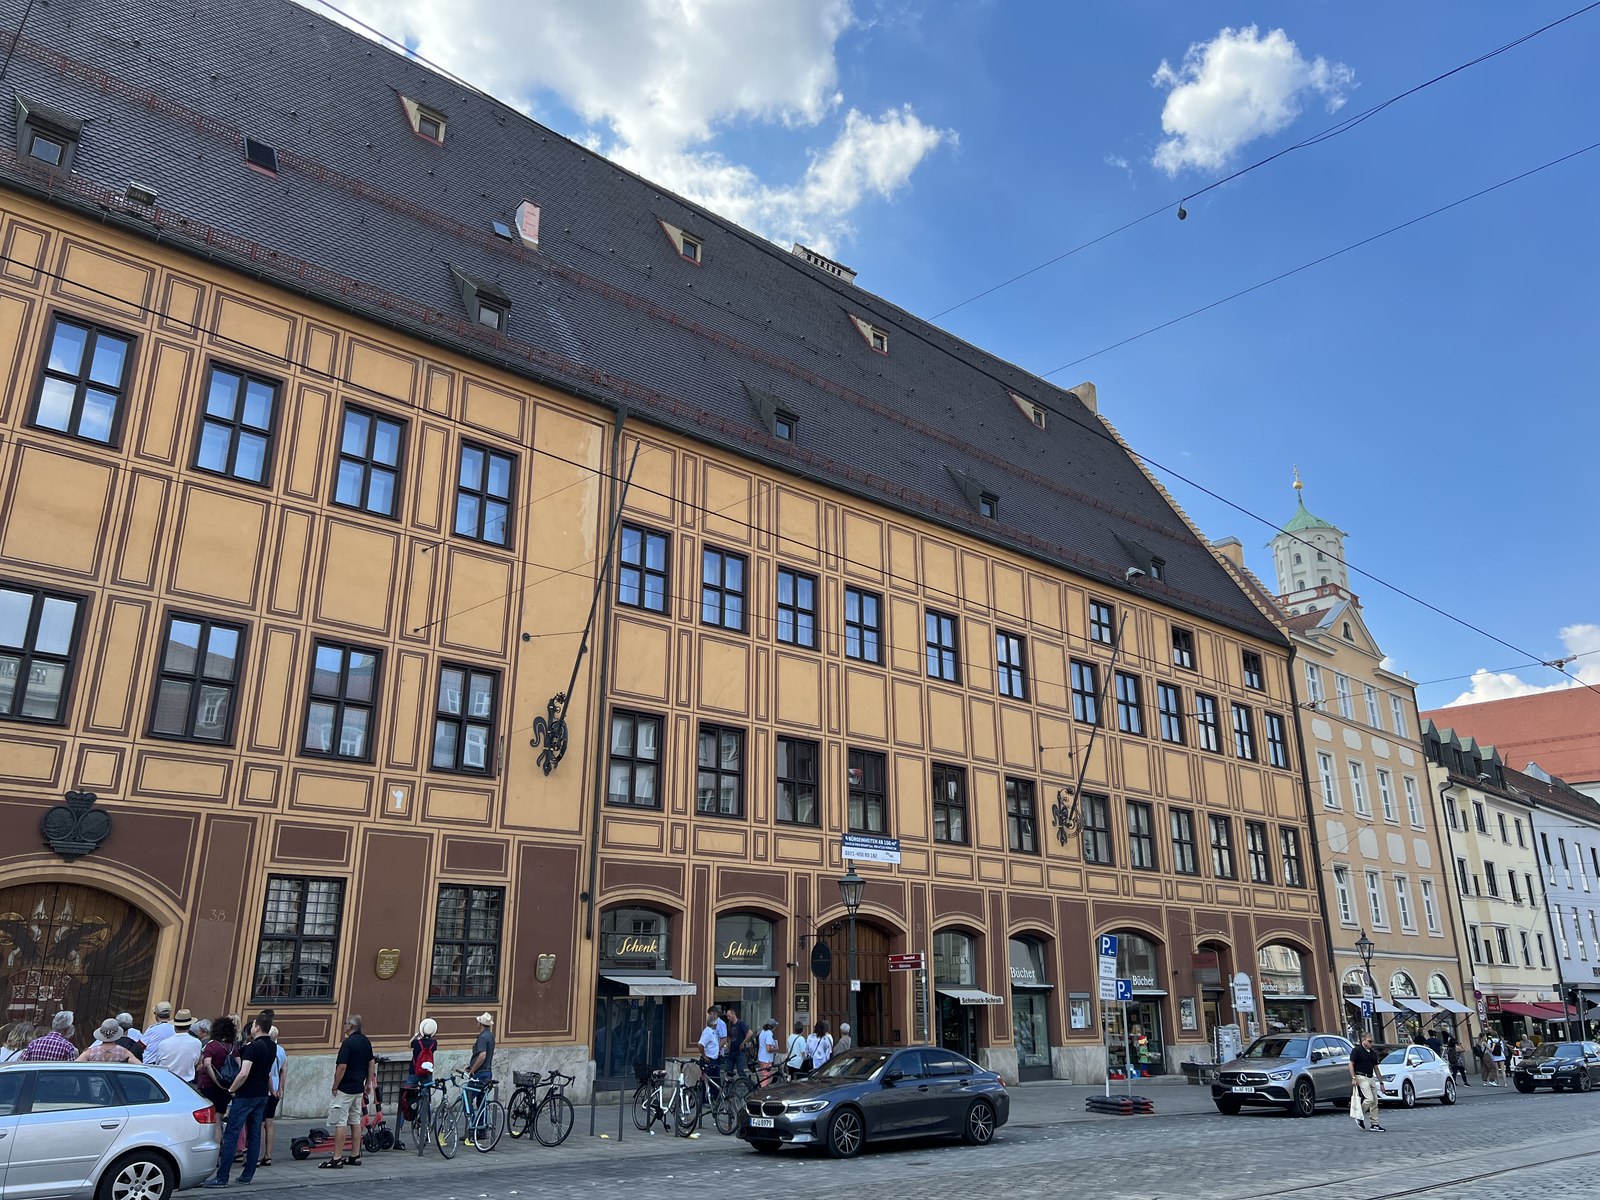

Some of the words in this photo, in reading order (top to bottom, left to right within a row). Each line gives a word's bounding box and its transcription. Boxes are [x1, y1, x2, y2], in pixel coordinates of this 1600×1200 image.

[210, 909, 226, 922] 38
[616, 936, 658, 955] Schenk
[723, 941, 758, 958] Schenk
[1102, 936, 1110, 954] P
[1010, 966, 1036, 978] Bücher
[1132, 975, 1154, 986] Bücher
[1118, 982, 1126, 999] P
